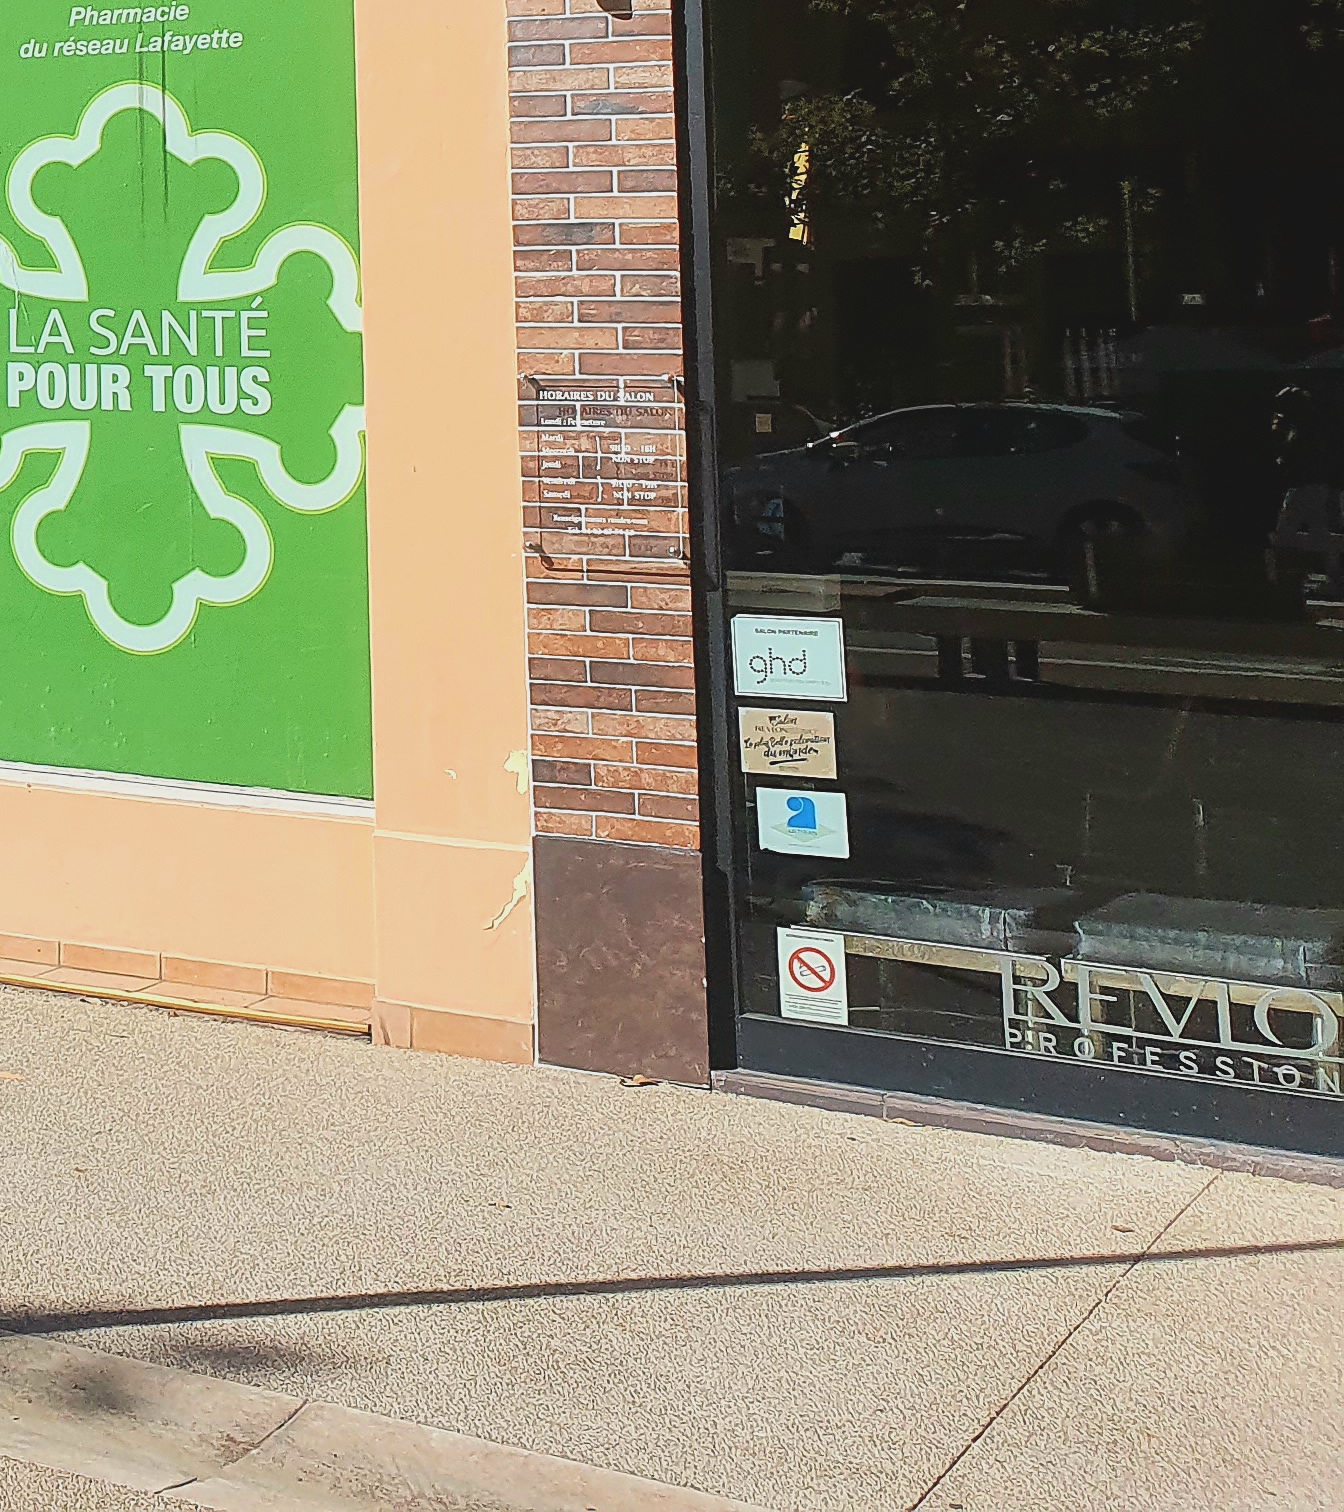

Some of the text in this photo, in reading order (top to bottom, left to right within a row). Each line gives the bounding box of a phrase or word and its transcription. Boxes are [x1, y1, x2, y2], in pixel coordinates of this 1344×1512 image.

[68, 1, 189, 26] Pharmacie
[19, 29, 243, 58] du réseau Lafayette
[8, 295, 271, 357] LA SANTÉ
[7, 362, 272, 415] POUR TOUS
[539, 390, 594, 401] HORAIRES
[597, 392, 614, 401] DU
[748, 647, 807, 685] ghd
